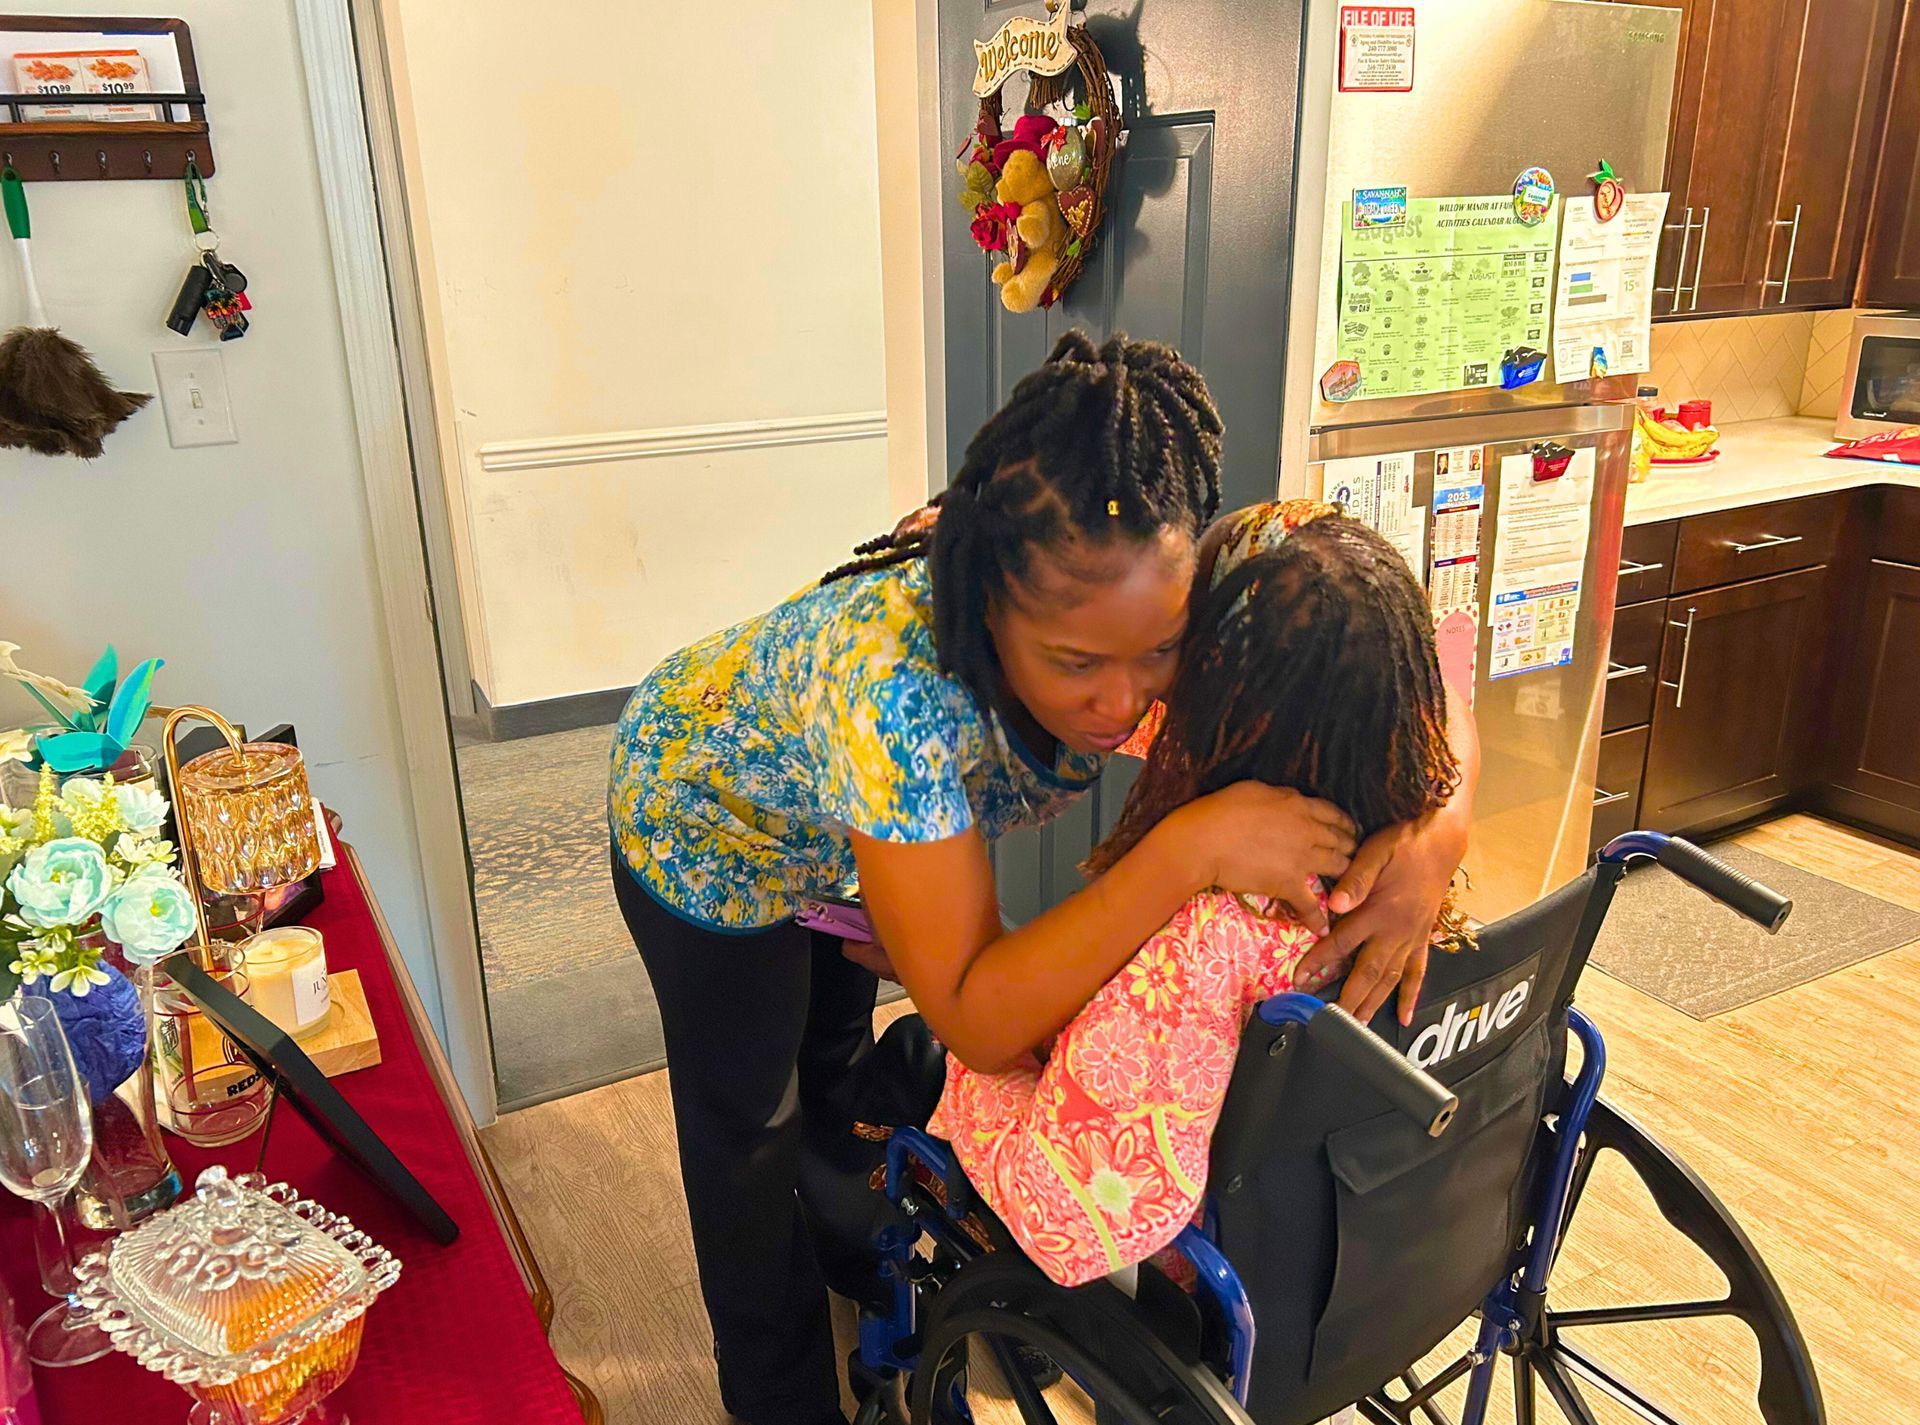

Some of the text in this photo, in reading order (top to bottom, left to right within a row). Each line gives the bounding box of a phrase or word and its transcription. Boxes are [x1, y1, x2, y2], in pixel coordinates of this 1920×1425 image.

[1343, 10, 1413, 26] FILE OF LIFE
[980, 29, 1058, 82] Welcome
[1439, 203, 1465, 212] WILLOW
[1467, 202, 1489, 211] MANOR
[1490, 202, 1499, 210] AT
[1437, 219, 1470, 228] ACTIVITIES
[1472, 217, 1505, 226] CALENDAR
[1352, 476, 1360, 515] IDES
[1447, 491, 1471, 503] 2025
[1446, 626, 1466, 634] NOTES
[1406, 980, 1530, 1070] drive
